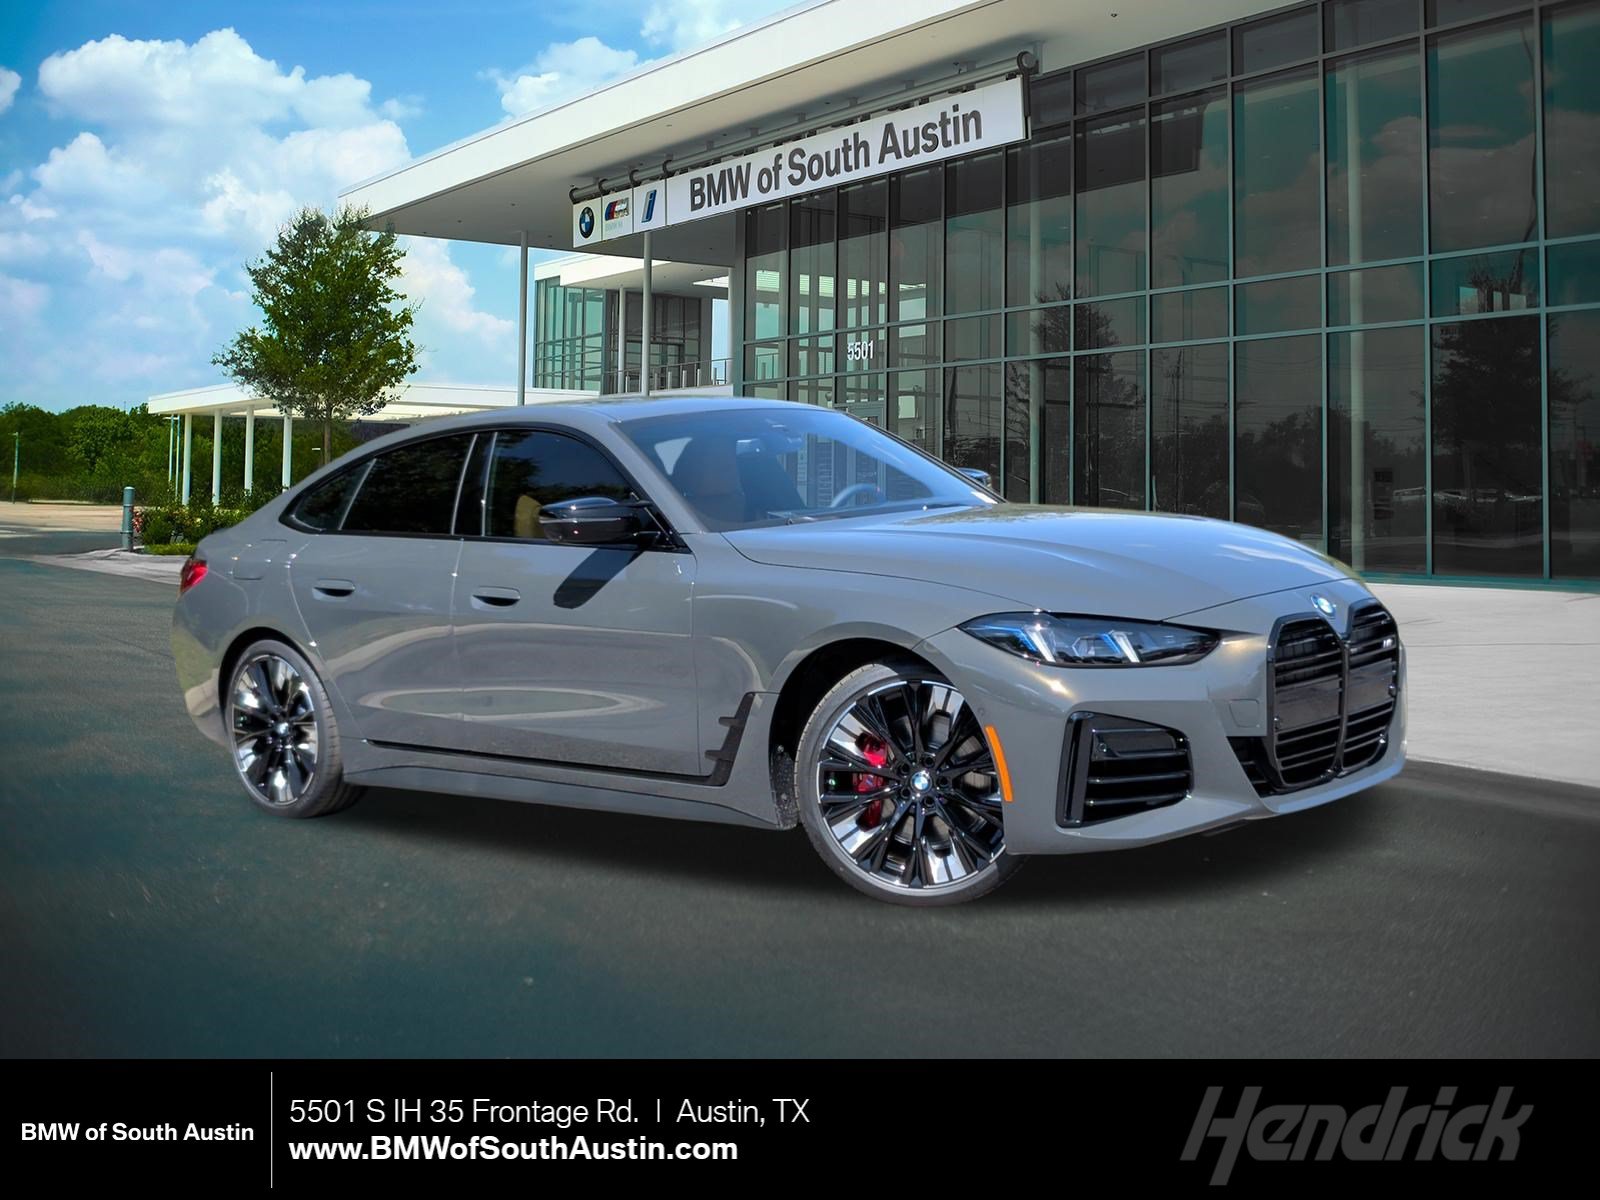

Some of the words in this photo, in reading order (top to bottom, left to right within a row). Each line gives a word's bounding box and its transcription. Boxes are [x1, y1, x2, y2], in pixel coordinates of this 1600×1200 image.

[690, 162, 752, 212] BMW
[757, 153, 783, 194] of
[787, 131, 870, 186] South
[878, 103, 983, 164] Austin
[847, 340, 874, 361] 5501
